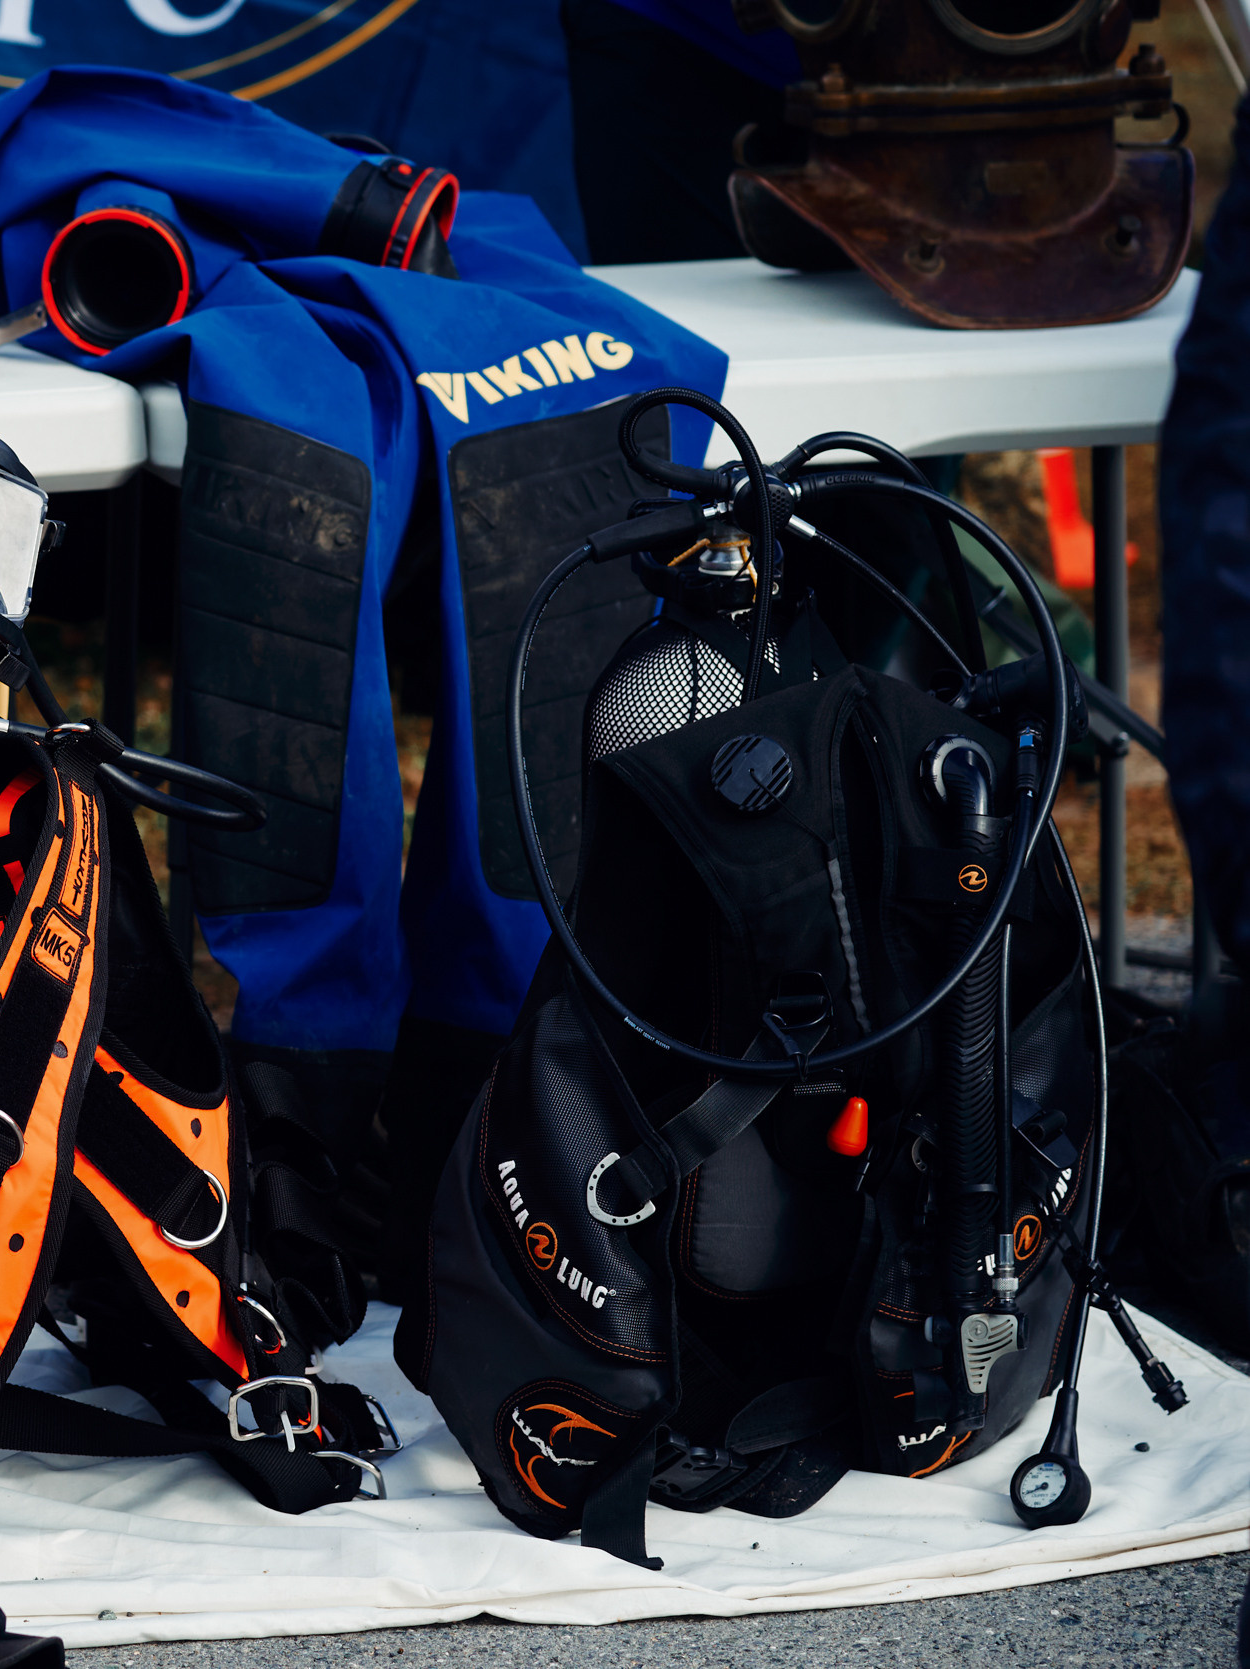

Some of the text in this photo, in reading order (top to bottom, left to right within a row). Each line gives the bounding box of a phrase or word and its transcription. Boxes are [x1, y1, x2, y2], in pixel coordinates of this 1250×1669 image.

[416, 332, 633, 424] VIKING
[825, 473, 875, 486] OCEANIC
[40, 928, 76, 967] MK5
[498, 1160, 529, 1230] AQUA
